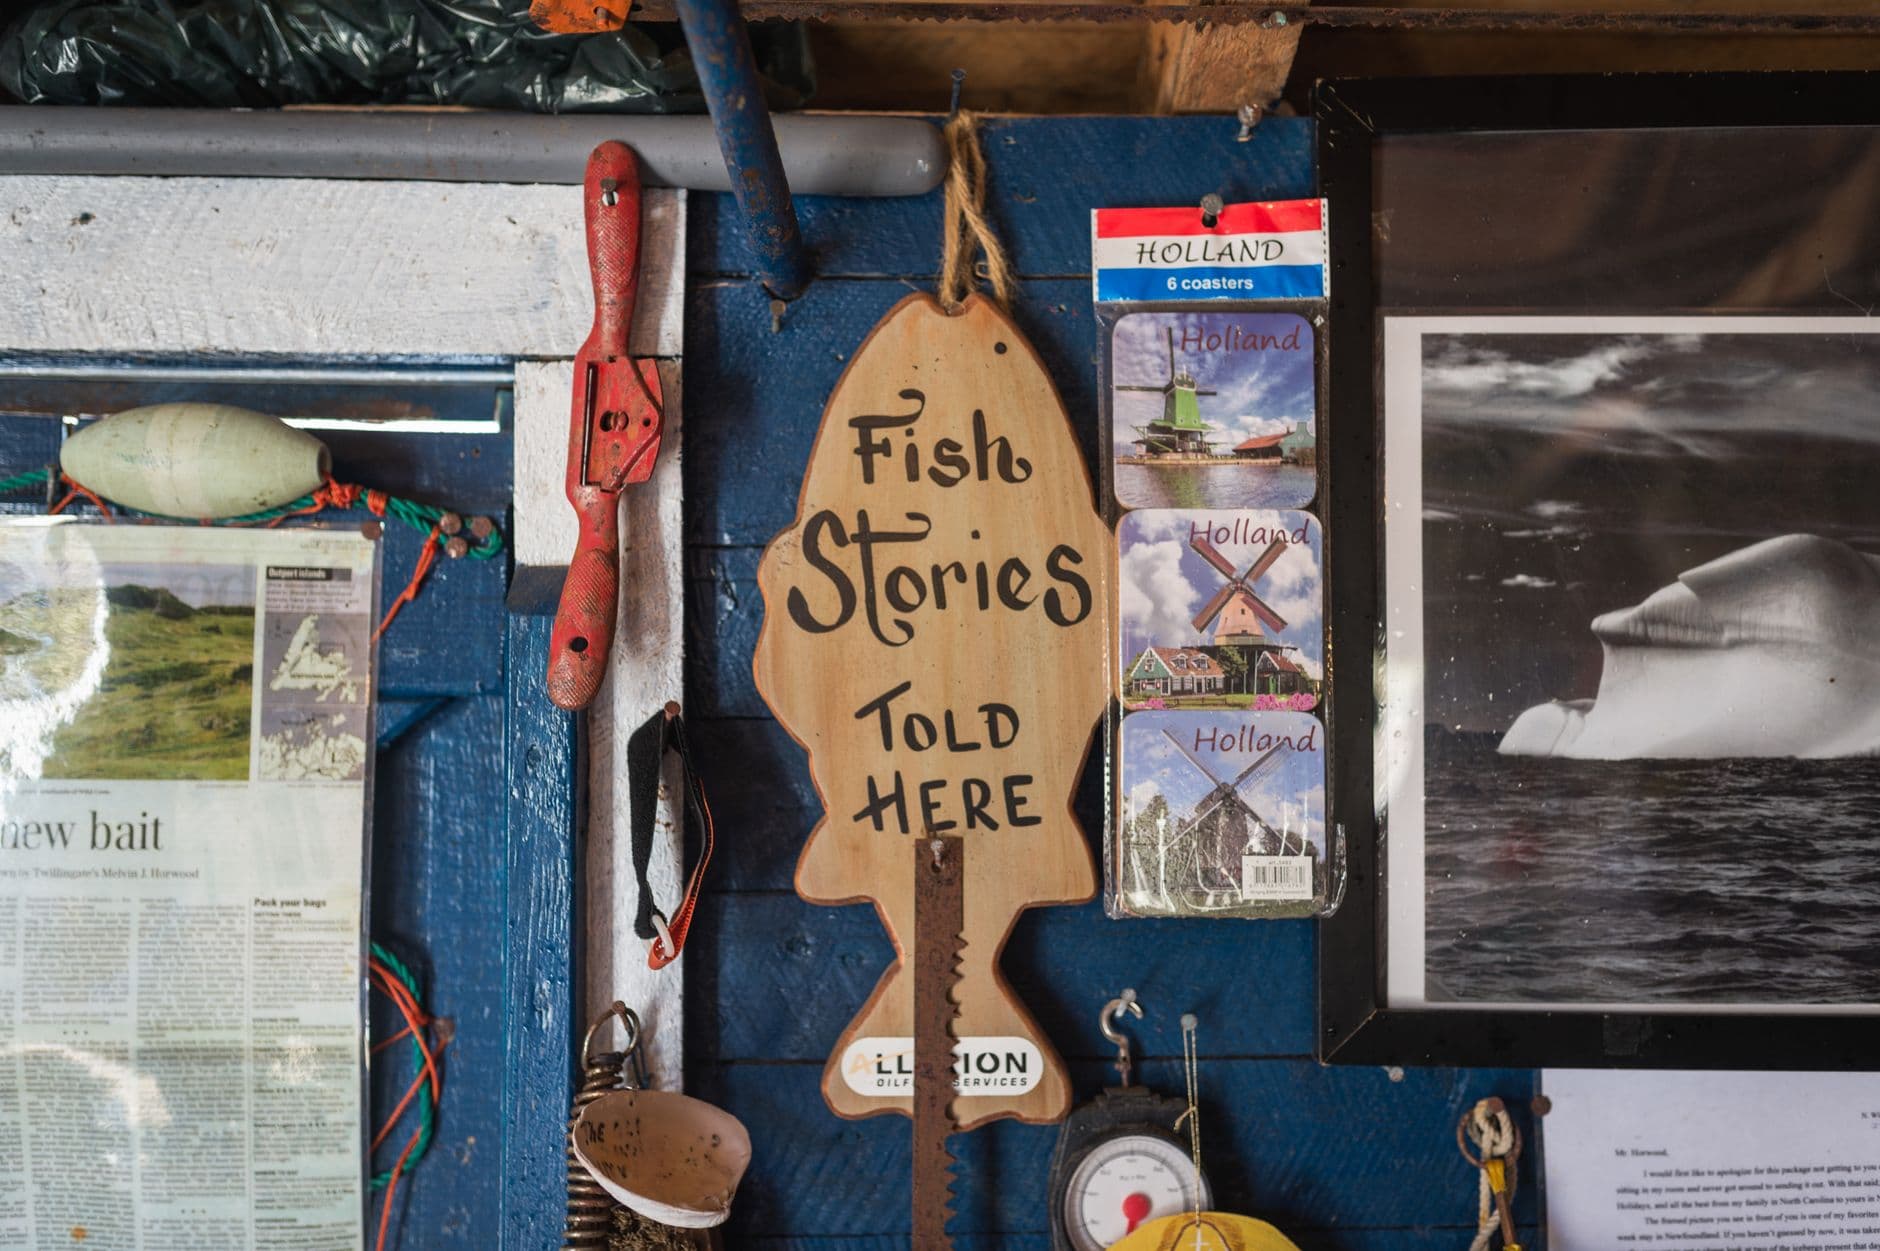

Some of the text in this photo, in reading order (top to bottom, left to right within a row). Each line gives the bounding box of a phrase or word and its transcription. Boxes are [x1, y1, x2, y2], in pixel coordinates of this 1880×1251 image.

[1136, 239, 1284, 264] HOLLAND
[1167, 276, 1254, 290] 6 coasters
[1181, 324, 1301, 353] Holland
[848, 388, 1033, 488] Fish
[1189, 518, 1310, 545] Holland
[787, 508, 1093, 647] Stories
[854, 680, 1020, 752] TOLD
[1194, 725, 1316, 752] Holland
[852, 770, 1042, 834] HERE
[91, 811, 163, 850] bait
[952, 1078, 1028, 1087] SERVICES
